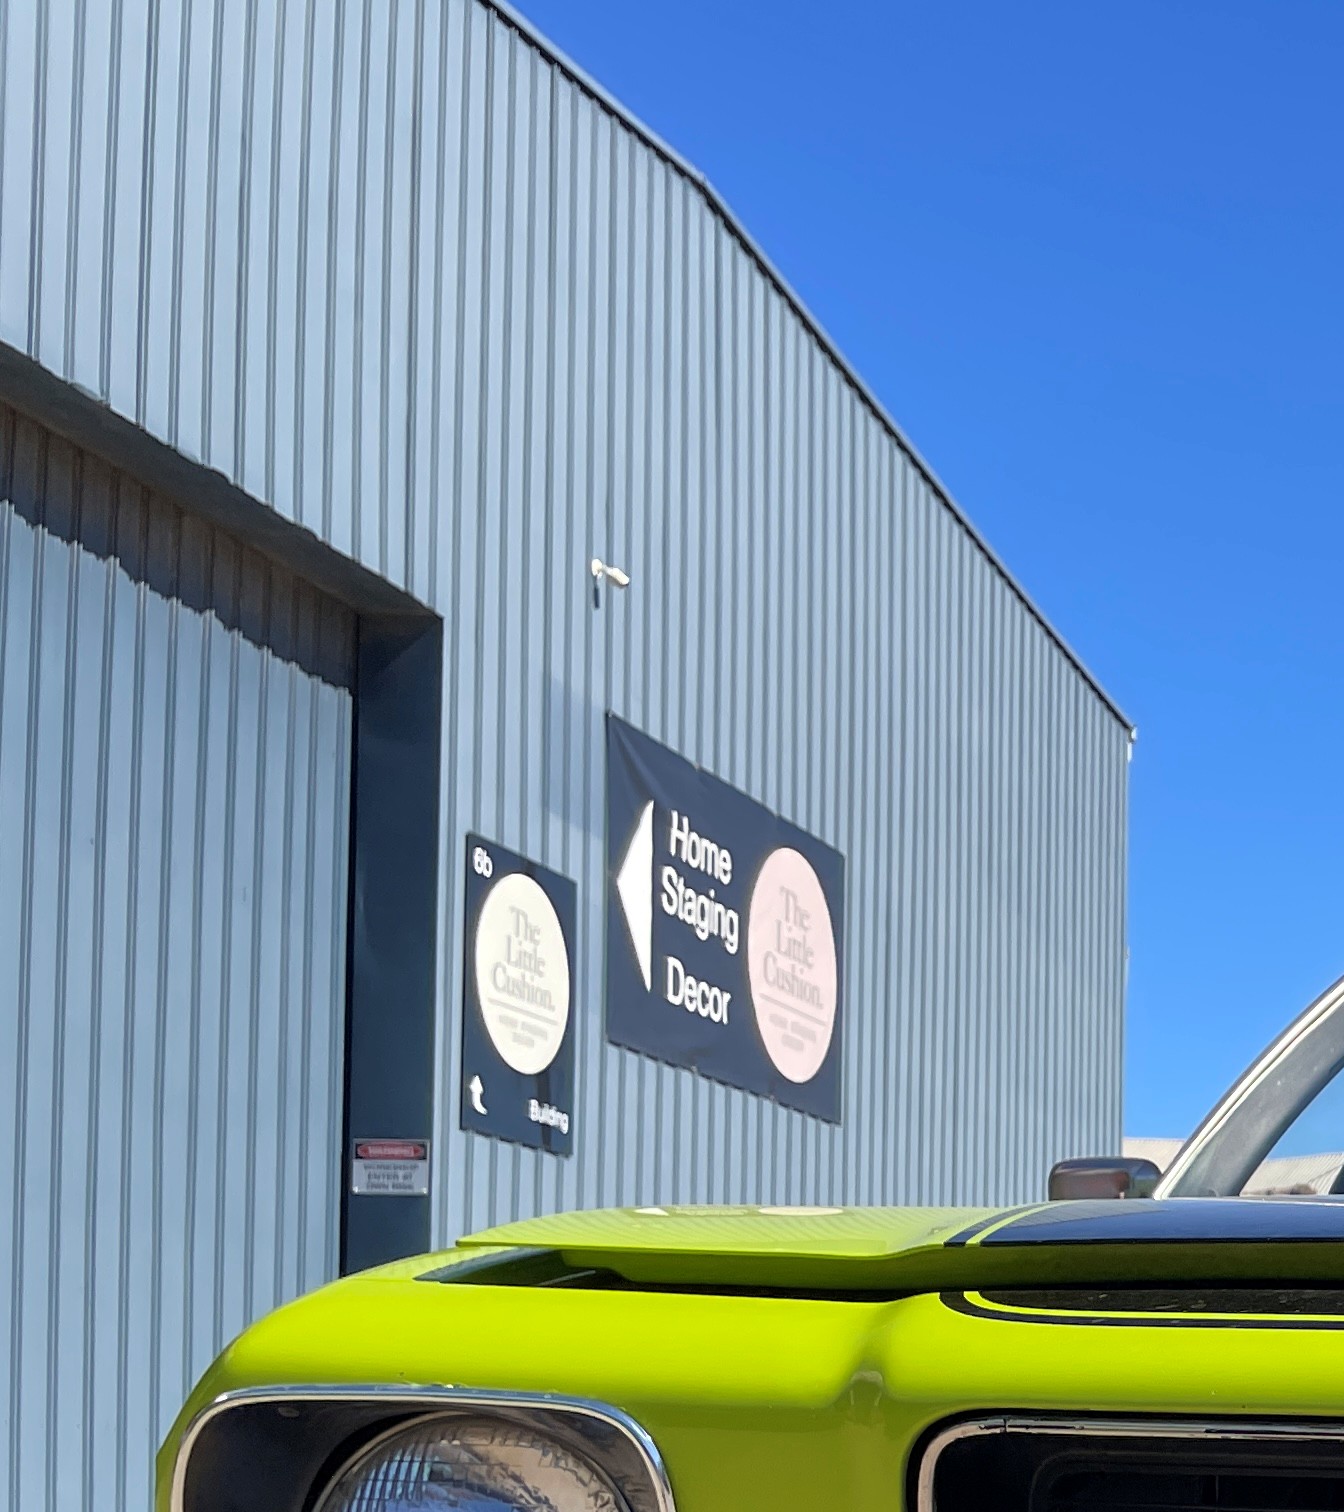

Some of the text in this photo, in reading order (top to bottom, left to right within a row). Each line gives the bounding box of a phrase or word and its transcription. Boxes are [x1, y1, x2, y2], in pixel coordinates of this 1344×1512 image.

[670, 809, 732, 885] Home
[509, 904, 541, 946] The
[661, 865, 739, 955] Staging
[779, 885, 811, 931] The
[505, 934, 546, 978] Little
[775, 919, 814, 970] Little
[666, 955, 732, 1025] Decor
